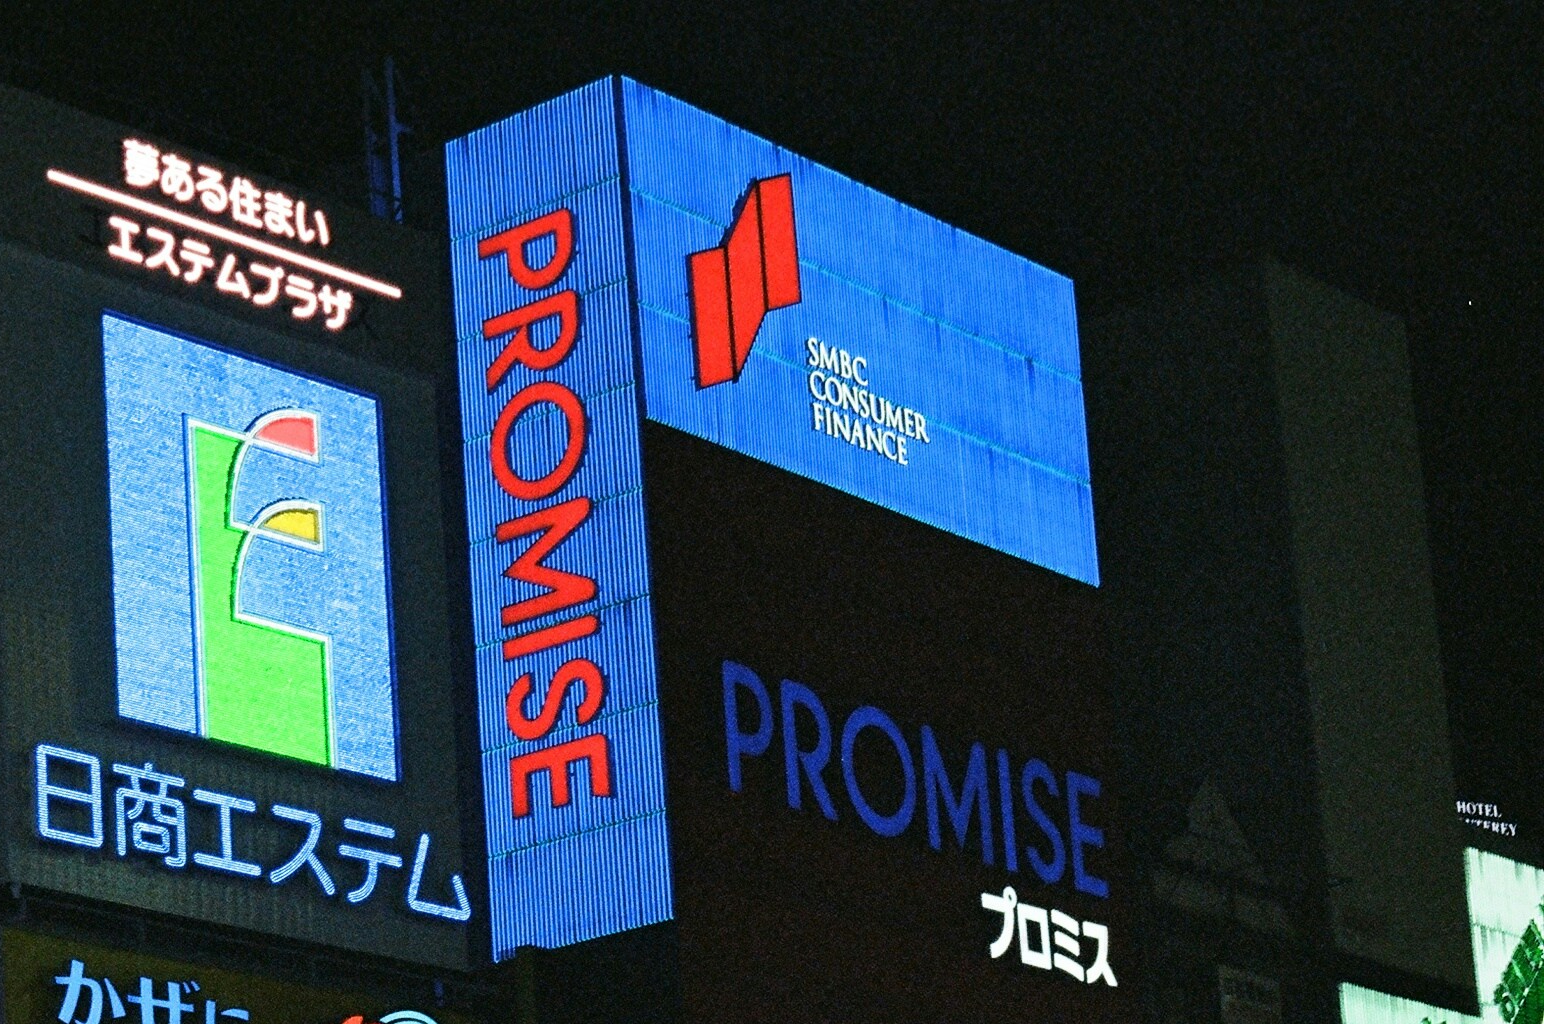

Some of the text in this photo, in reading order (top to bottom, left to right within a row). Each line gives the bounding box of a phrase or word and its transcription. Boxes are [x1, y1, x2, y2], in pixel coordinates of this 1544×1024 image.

[123, 137, 330, 246] 夢ある住まい
[107, 214, 354, 330] エステムプラザ
[808, 336, 869, 387] SMBC
[809, 369, 931, 444] CONSUMER
[812, 402, 909, 465] FINANCE
[477, 206, 612, 819] PROMISE
[722, 659, 1110, 899] PROMISE
[1456, 800, 1502, 818] HOTEL
[36, 744, 472, 921] 日商エステム
[981, 886, 1118, 987] プロミス
